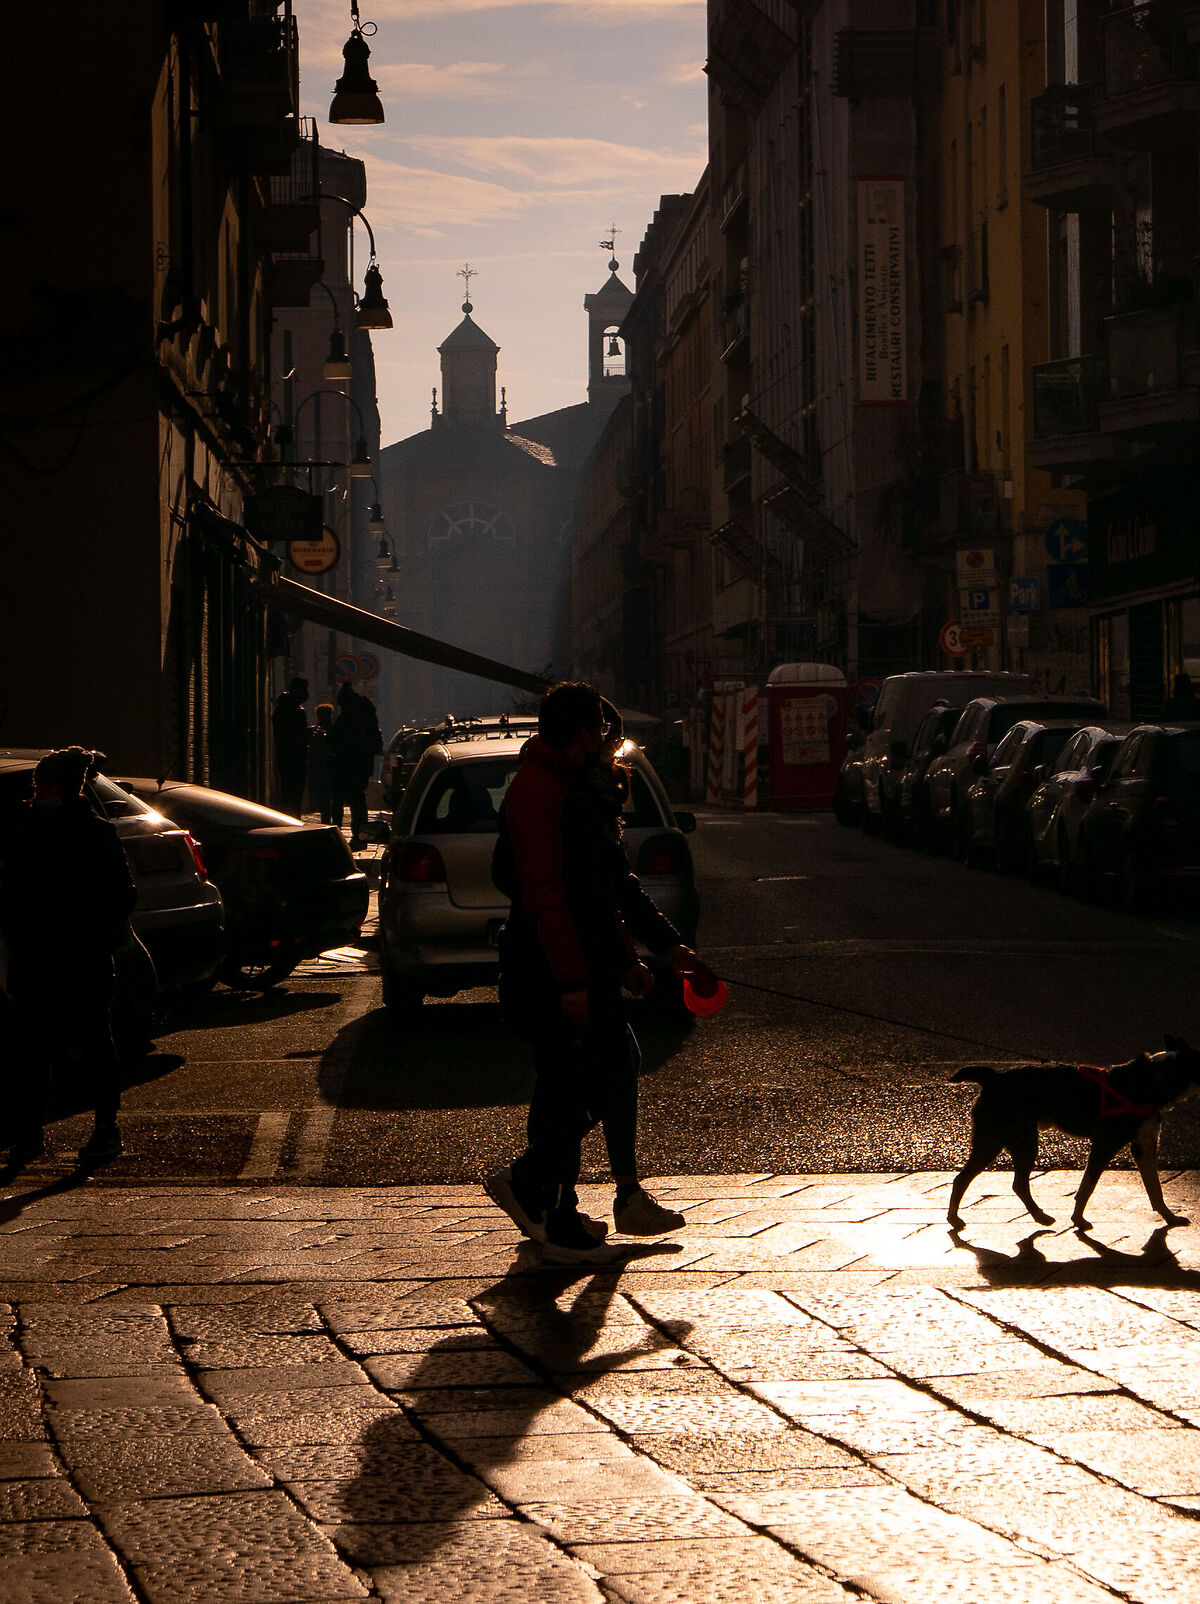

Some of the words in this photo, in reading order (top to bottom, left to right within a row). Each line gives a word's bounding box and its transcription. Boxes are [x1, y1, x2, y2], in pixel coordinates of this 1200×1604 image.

[864, 244, 876, 281] TETTI
[888, 227, 901, 327] CONSERVATIVI
[864, 285, 877, 381] RIFACIMENTO
[890, 332, 902, 398] RESTAURI
